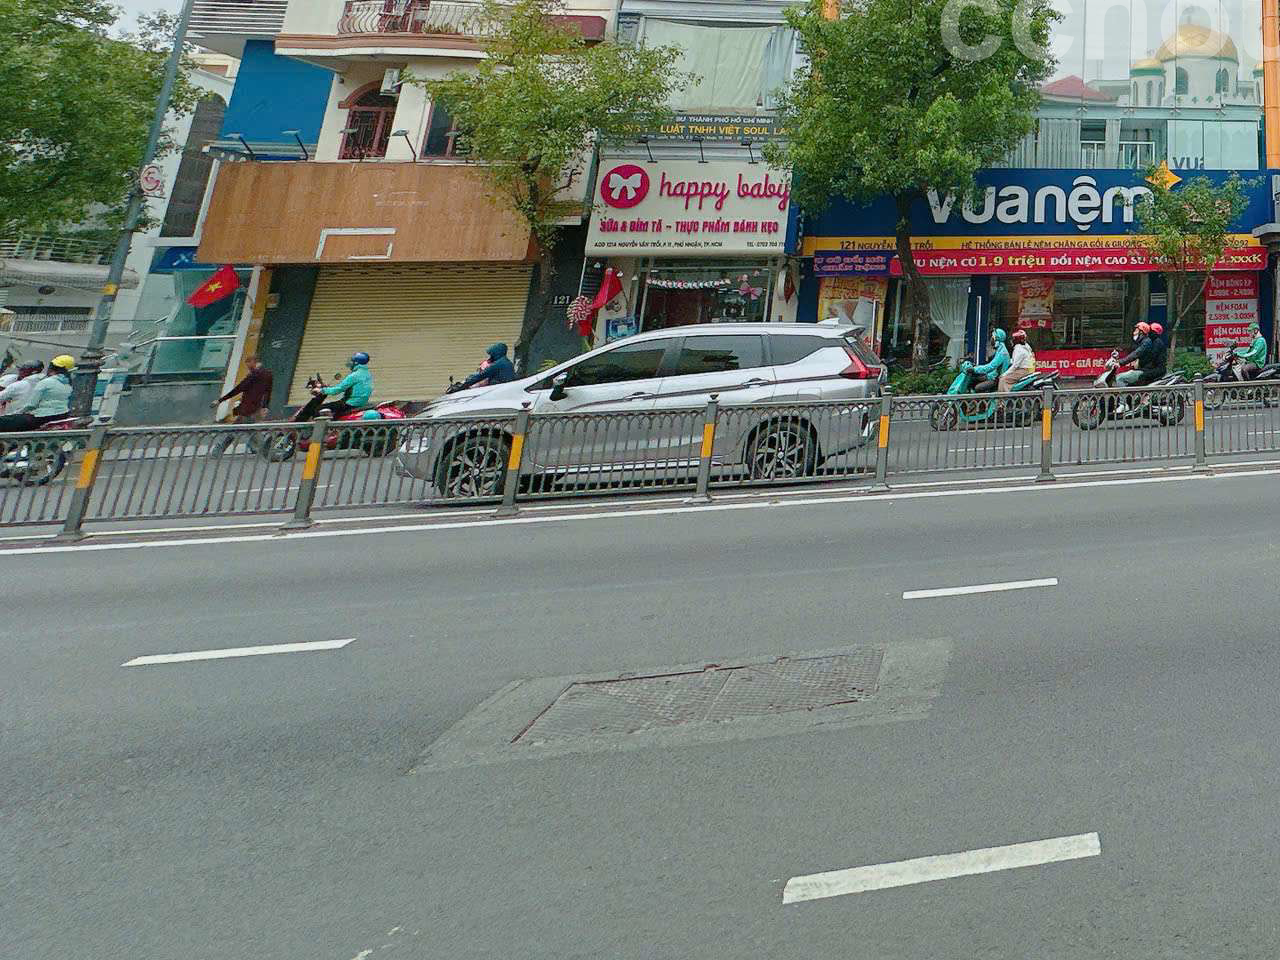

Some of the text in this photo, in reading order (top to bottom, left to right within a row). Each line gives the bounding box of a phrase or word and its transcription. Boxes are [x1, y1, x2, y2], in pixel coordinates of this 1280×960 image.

[688, 125, 714, 135] TNHH
[743, 126, 769, 135] SOUL
[659, 172, 791, 211] happy baby
[840, 241, 856, 250] 121
[929, 256, 957, 269] NỆM
[979, 256, 1004, 267] 1.9
[1007, 254, 1046, 269] triệu
[1075, 254, 1102, 268] NỆM
[1105, 256, 1128, 266] CAO
[1035, 360, 1057, 369] SALE
[1060, 360, 1070, 369] TO
